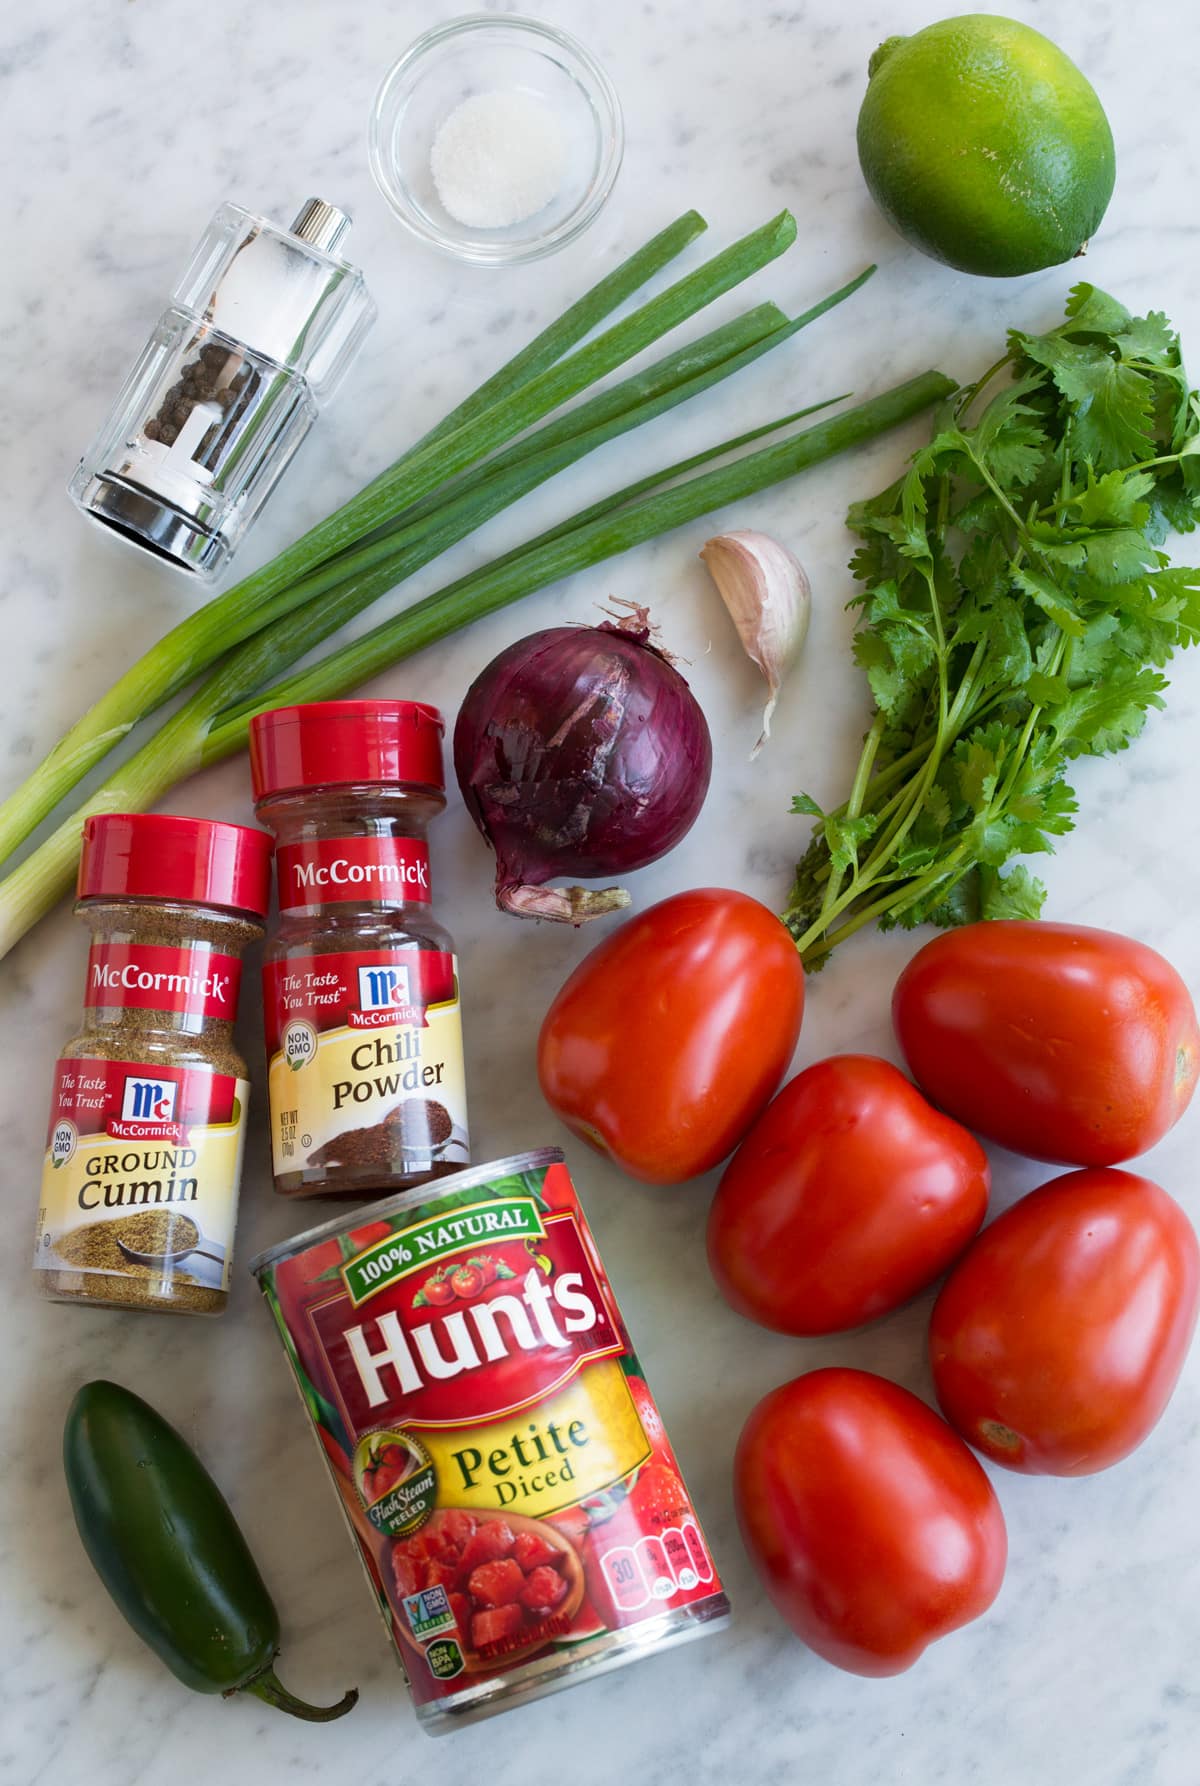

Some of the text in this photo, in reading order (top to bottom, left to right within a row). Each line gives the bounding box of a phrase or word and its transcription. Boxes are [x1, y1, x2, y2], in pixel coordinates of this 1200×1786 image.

[293, 859, 429, 888] McCormick
[92, 964, 227, 1003] McCormick
[283, 972, 339, 991] The Taste
[283, 995, 304, 1009] You
[352, 1009, 420, 1026] McCormick
[288, 1031, 310, 1044] NON
[288, 1042, 311, 1054] GMO
[351, 1030, 422, 1072] Chili
[61, 1074, 106, 1089] The Taste
[332, 1061, 445, 1110] Powder
[58, 1093, 73, 1107] You
[55, 1131, 72, 1141] NON
[111, 1121, 182, 1137] McCormick
[54, 1142, 71, 1153] GMO
[86, 1149, 198, 1176] GROUND
[78, 1171, 199, 1210] Cumin
[356, 1208, 529, 1286] 100% NATURAL
[451, 1419, 590, 1491] Petite
[494, 1458, 576, 1507] Diced
[388, 1499, 427, 1530] PEELED
[611, 1557, 635, 1584] 30
[423, 1588, 442, 1602] NON
[425, 1598, 446, 1611] GMO
[431, 1654, 452, 1667] BPA
